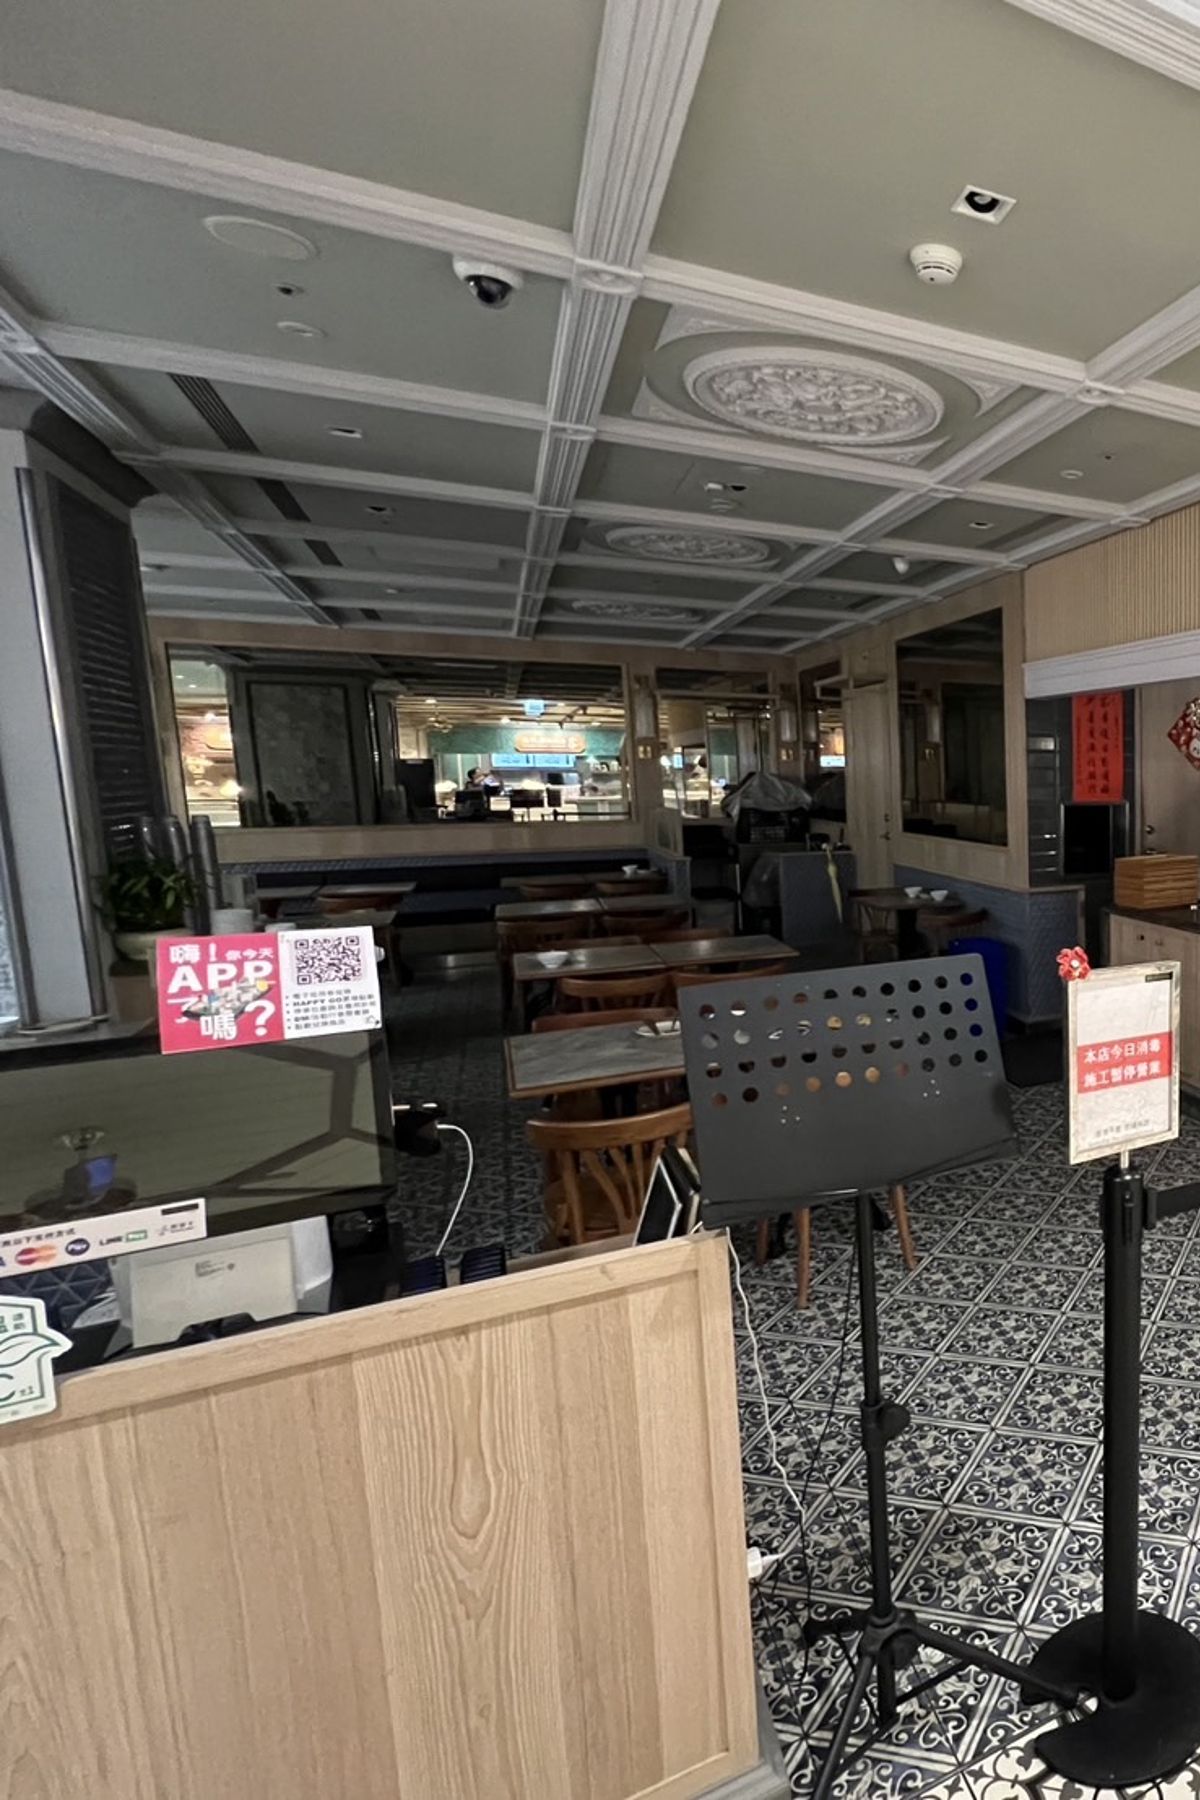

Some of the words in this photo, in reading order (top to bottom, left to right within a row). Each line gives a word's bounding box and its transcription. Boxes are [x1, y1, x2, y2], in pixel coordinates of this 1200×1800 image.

[167, 961, 273, 993] APP
[1085, 1039, 1161, 1064] 本店今日消毒
[1084, 1060, 1161, 1088] 施工暫停營業
